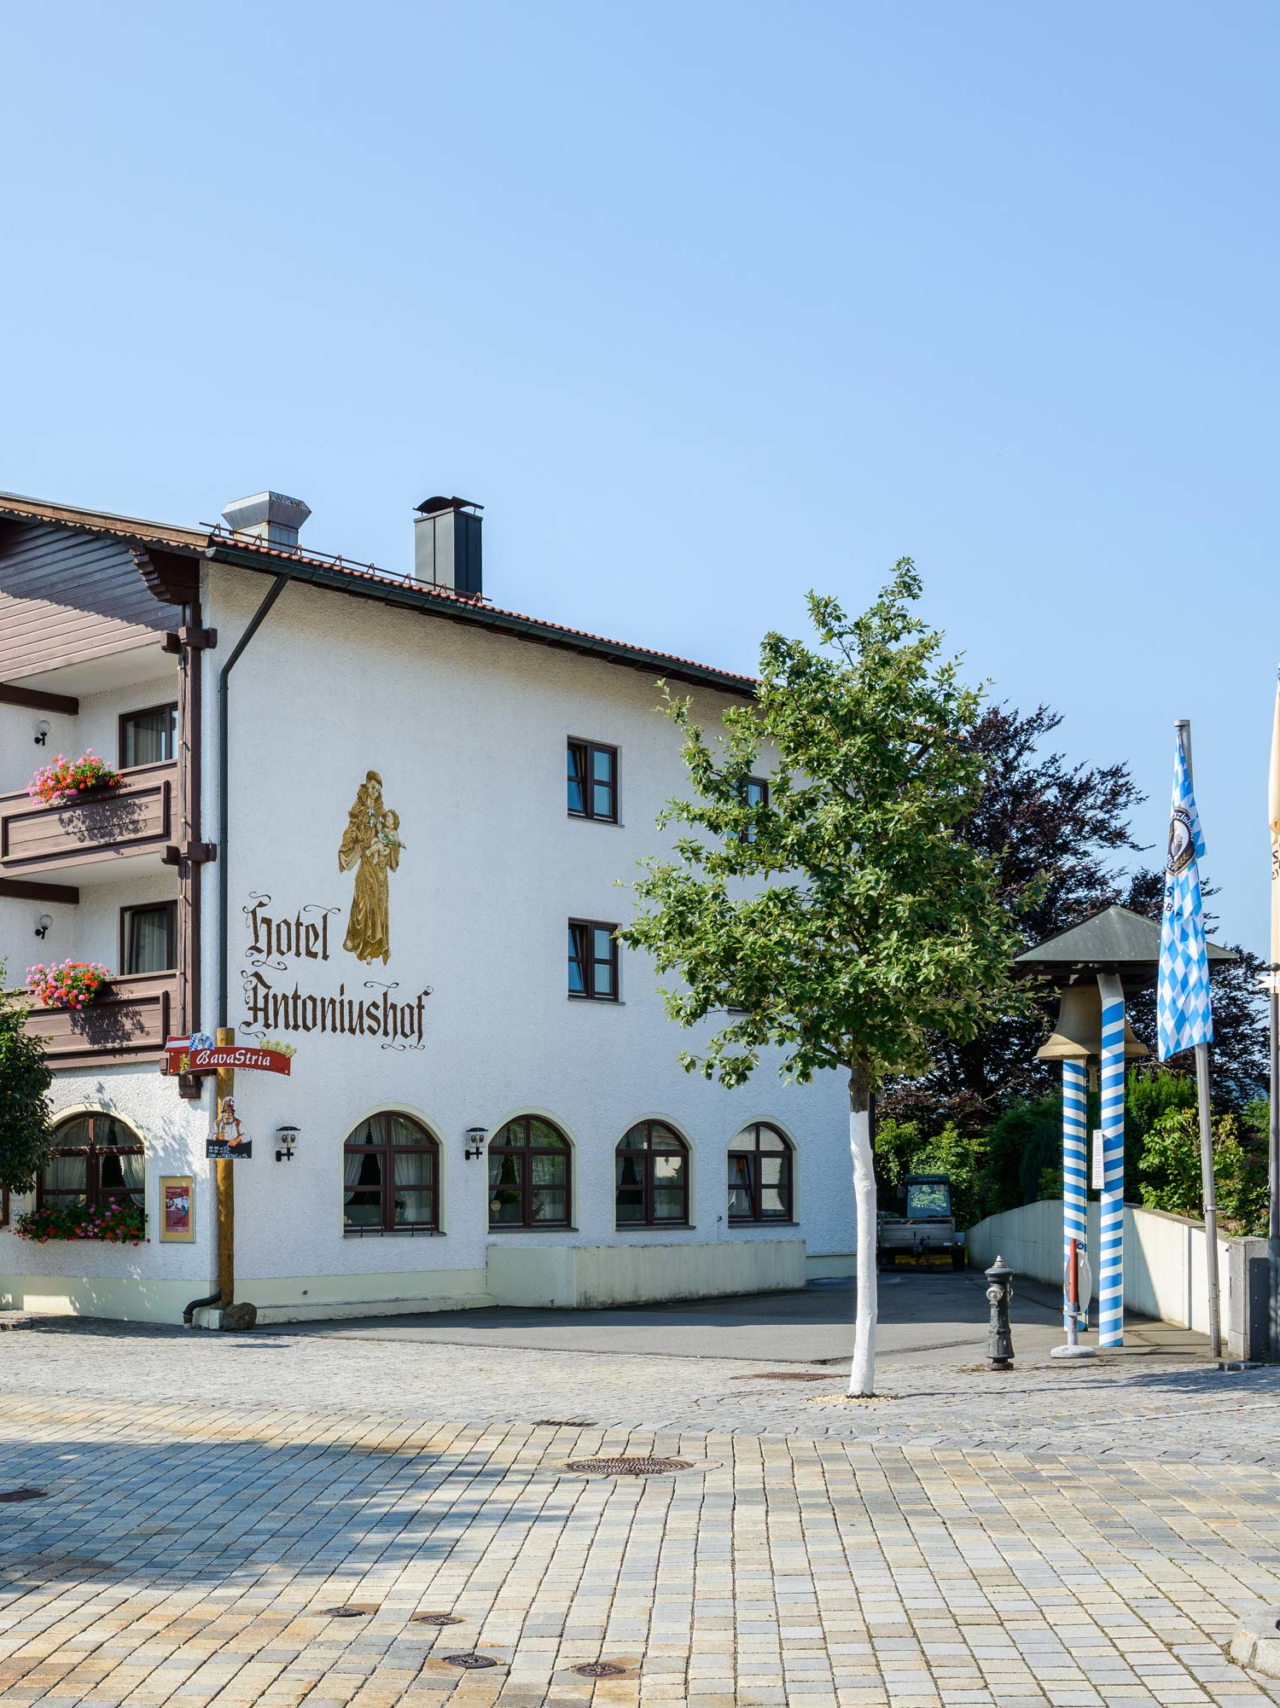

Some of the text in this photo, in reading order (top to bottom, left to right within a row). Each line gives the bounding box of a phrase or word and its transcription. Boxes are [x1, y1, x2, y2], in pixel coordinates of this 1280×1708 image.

[243, 892, 340, 969] Hotel
[239, 970, 434, 1050] Antoniushof
[196, 1049, 271, 1066] BavaStria
